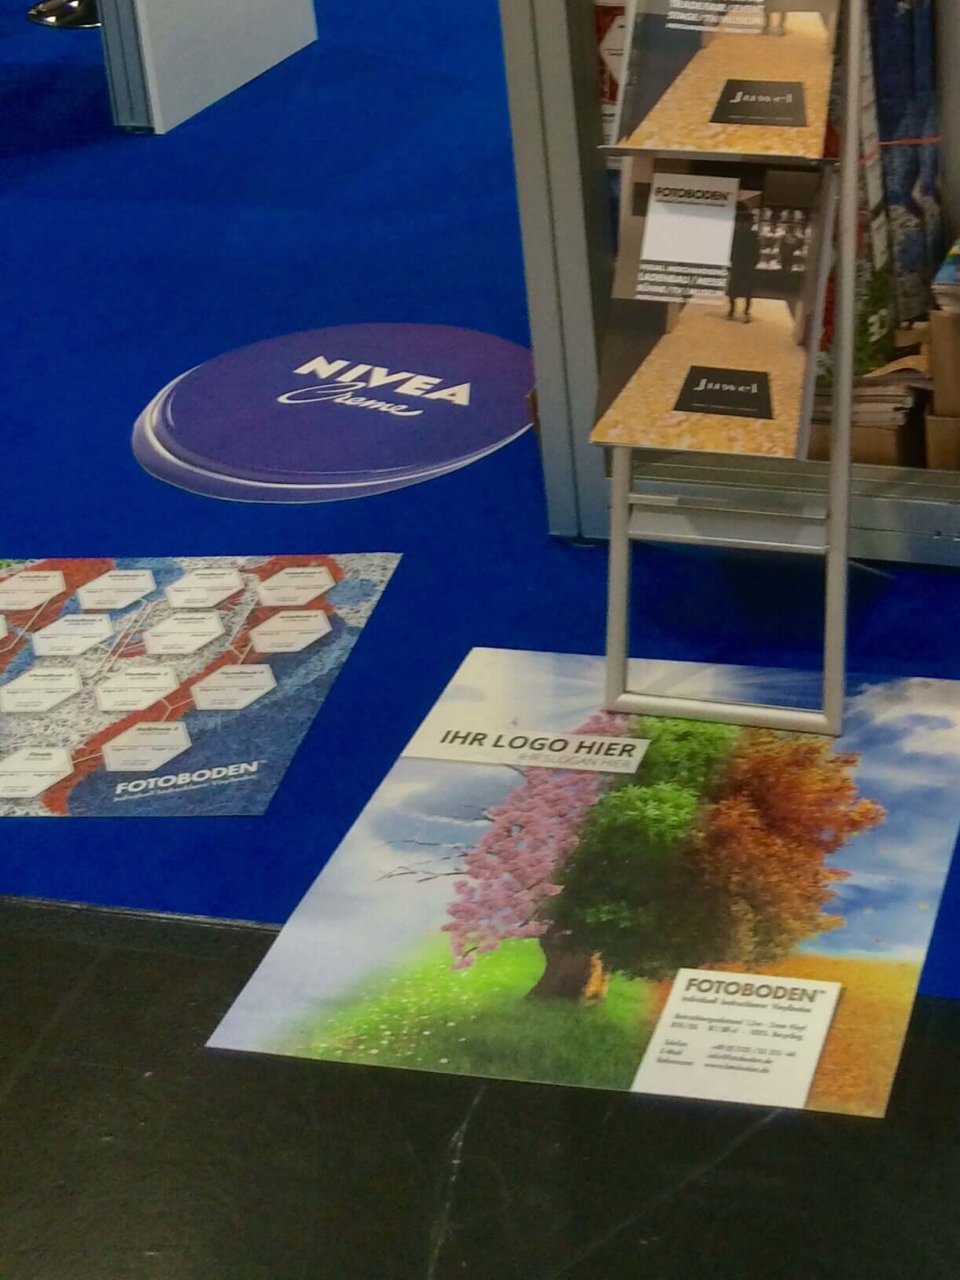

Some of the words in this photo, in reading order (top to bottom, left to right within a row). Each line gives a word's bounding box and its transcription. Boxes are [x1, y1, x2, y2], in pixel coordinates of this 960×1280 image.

[293, 355, 471, 406] NIVEA
[277, 381, 424, 416] Creme
[440, 730, 487, 746] IHR
[492, 734, 568, 752] LOGO
[573, 739, 637, 758] HIER
[114, 761, 260, 795] FOTOBODEN
[684, 977, 818, 1003] FOTOBODEN
